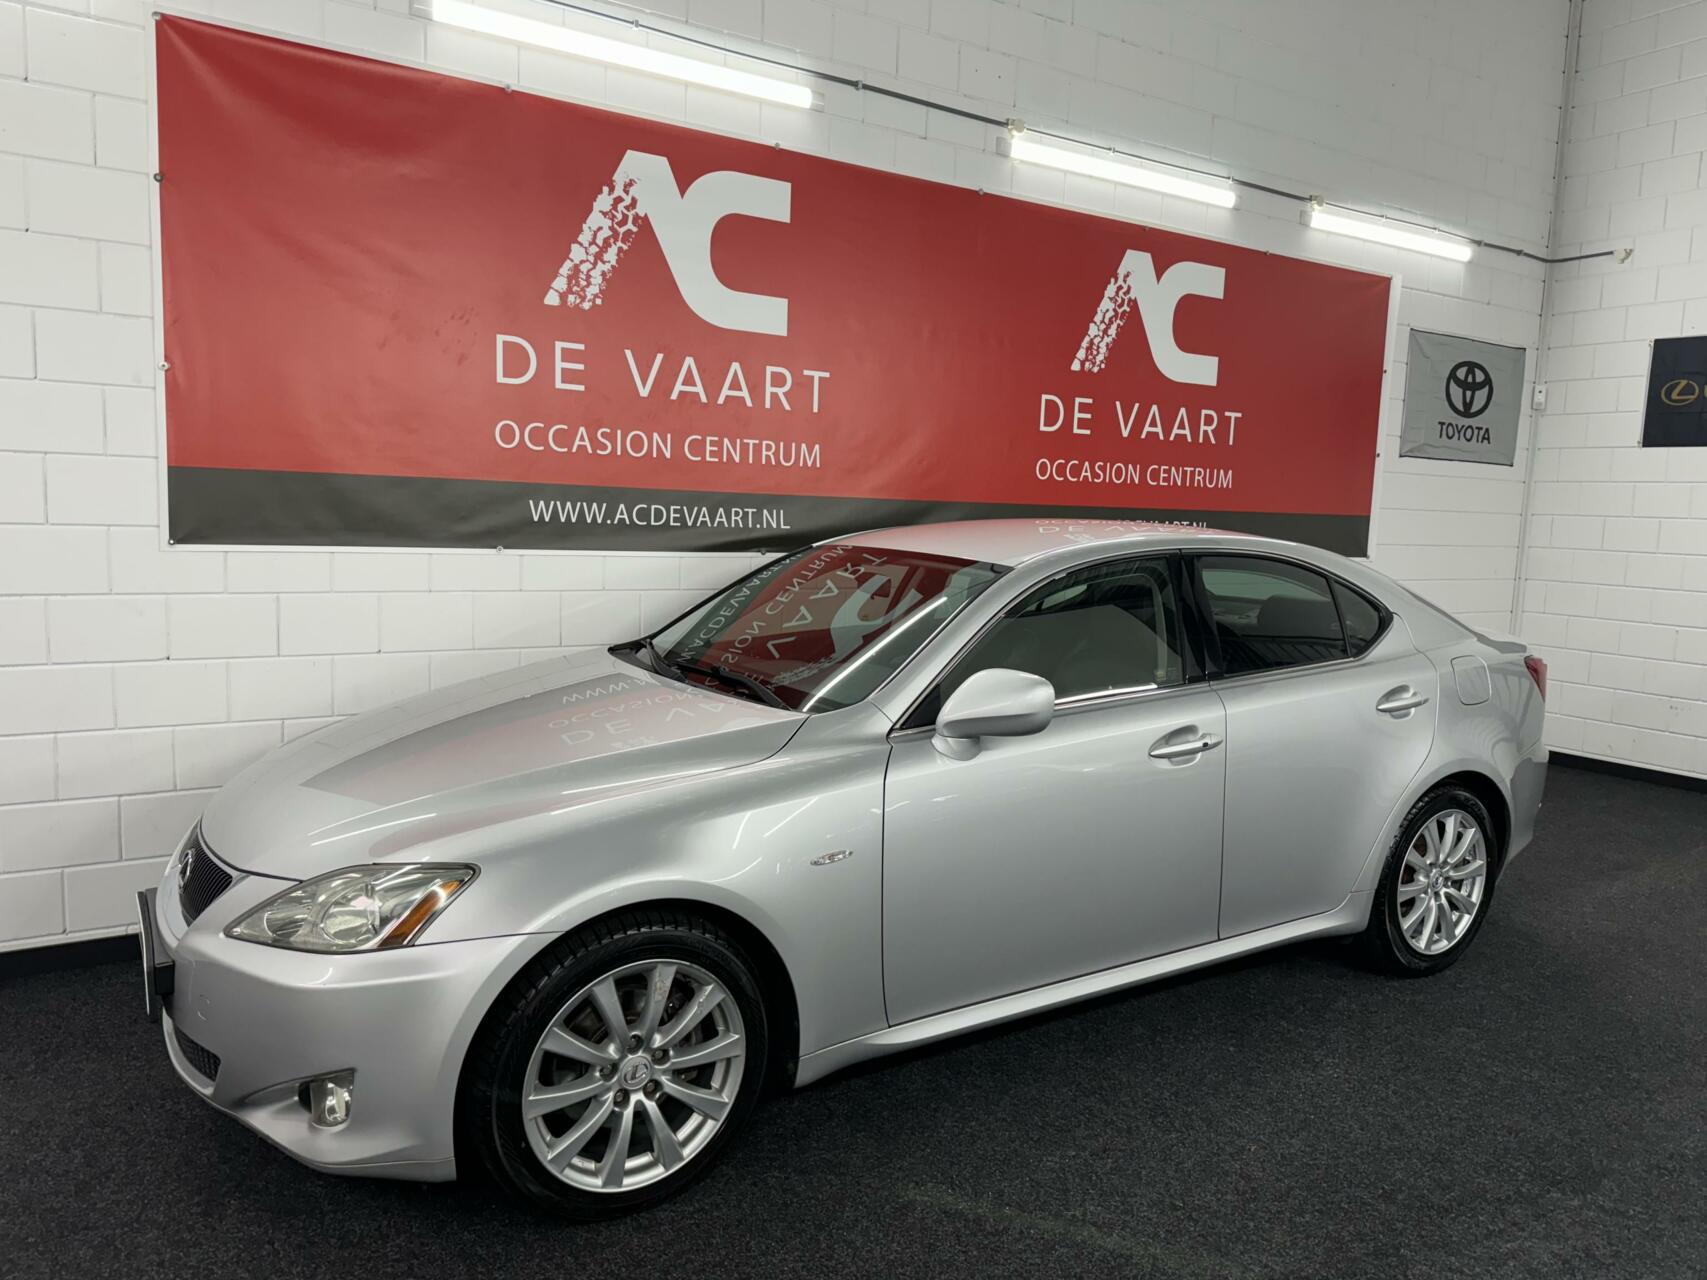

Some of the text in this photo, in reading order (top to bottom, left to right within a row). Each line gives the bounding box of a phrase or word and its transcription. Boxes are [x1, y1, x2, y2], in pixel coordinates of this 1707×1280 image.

[496, 334, 831, 413] DE VAART
[1039, 394, 1242, 446] DE VAART
[1438, 421, 1492, 445] TOYOTA
[494, 420, 821, 468] OCCASION CENTRUM
[1036, 458, 1233, 489] OCCASION CENTRUM
[529, 499, 791, 529] WWW.ACDEVAART.NL
